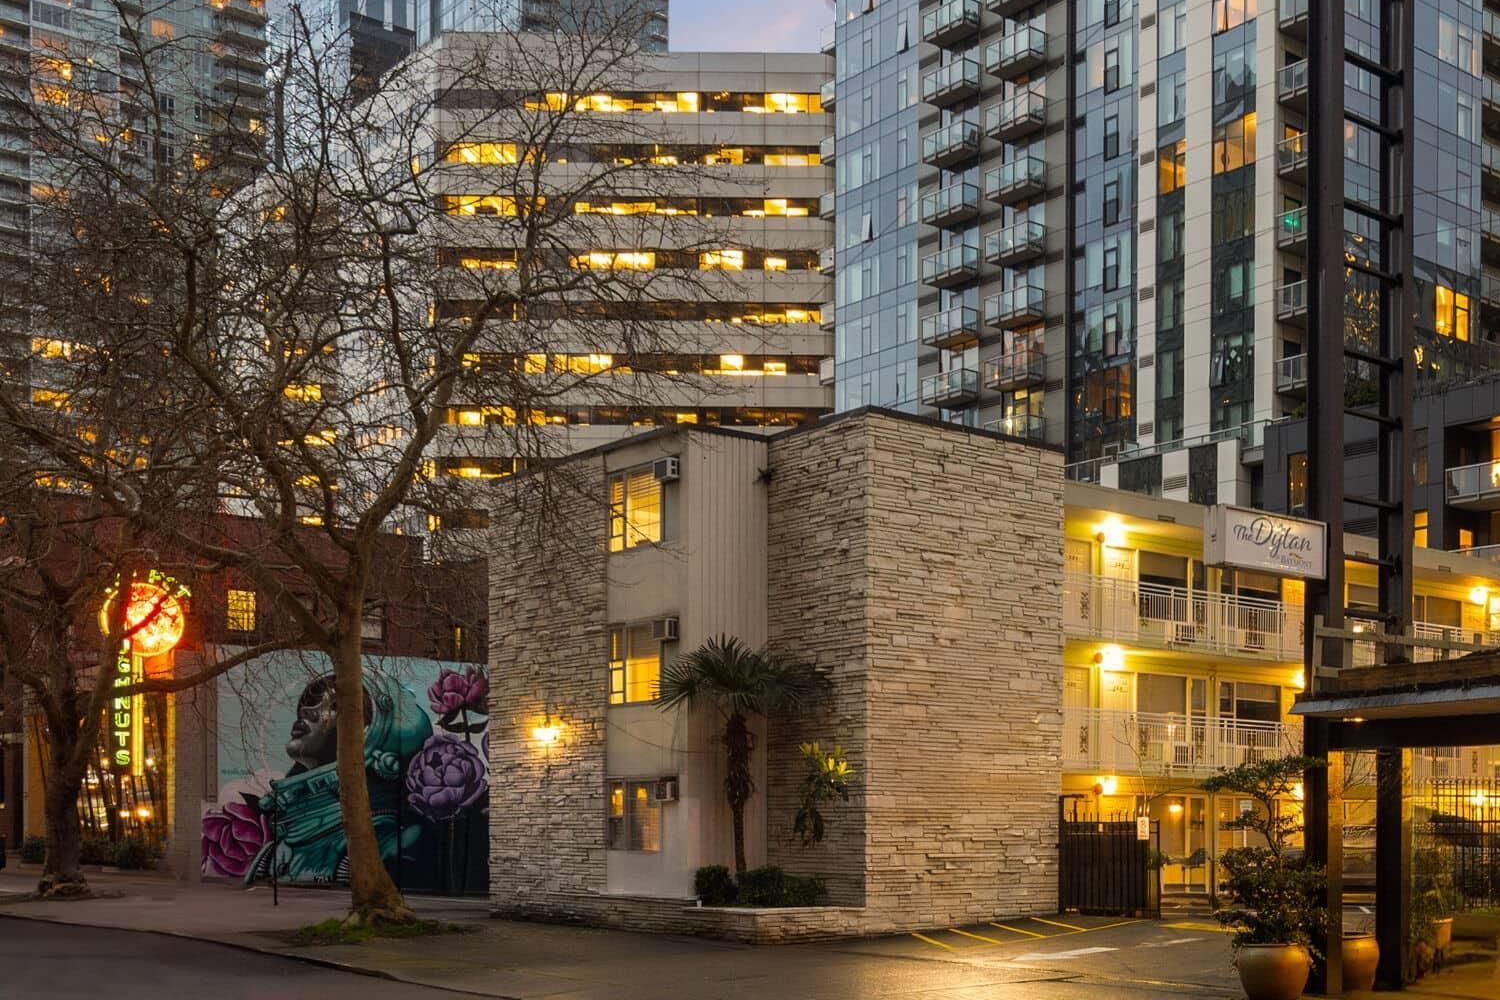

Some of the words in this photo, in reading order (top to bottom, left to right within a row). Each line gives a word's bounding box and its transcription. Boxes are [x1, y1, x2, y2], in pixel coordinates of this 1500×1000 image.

[1233, 524, 1252, 541] The
[1250, 517, 1312, 558] Dylan
[114, 621, 131, 766] GHNUTS
